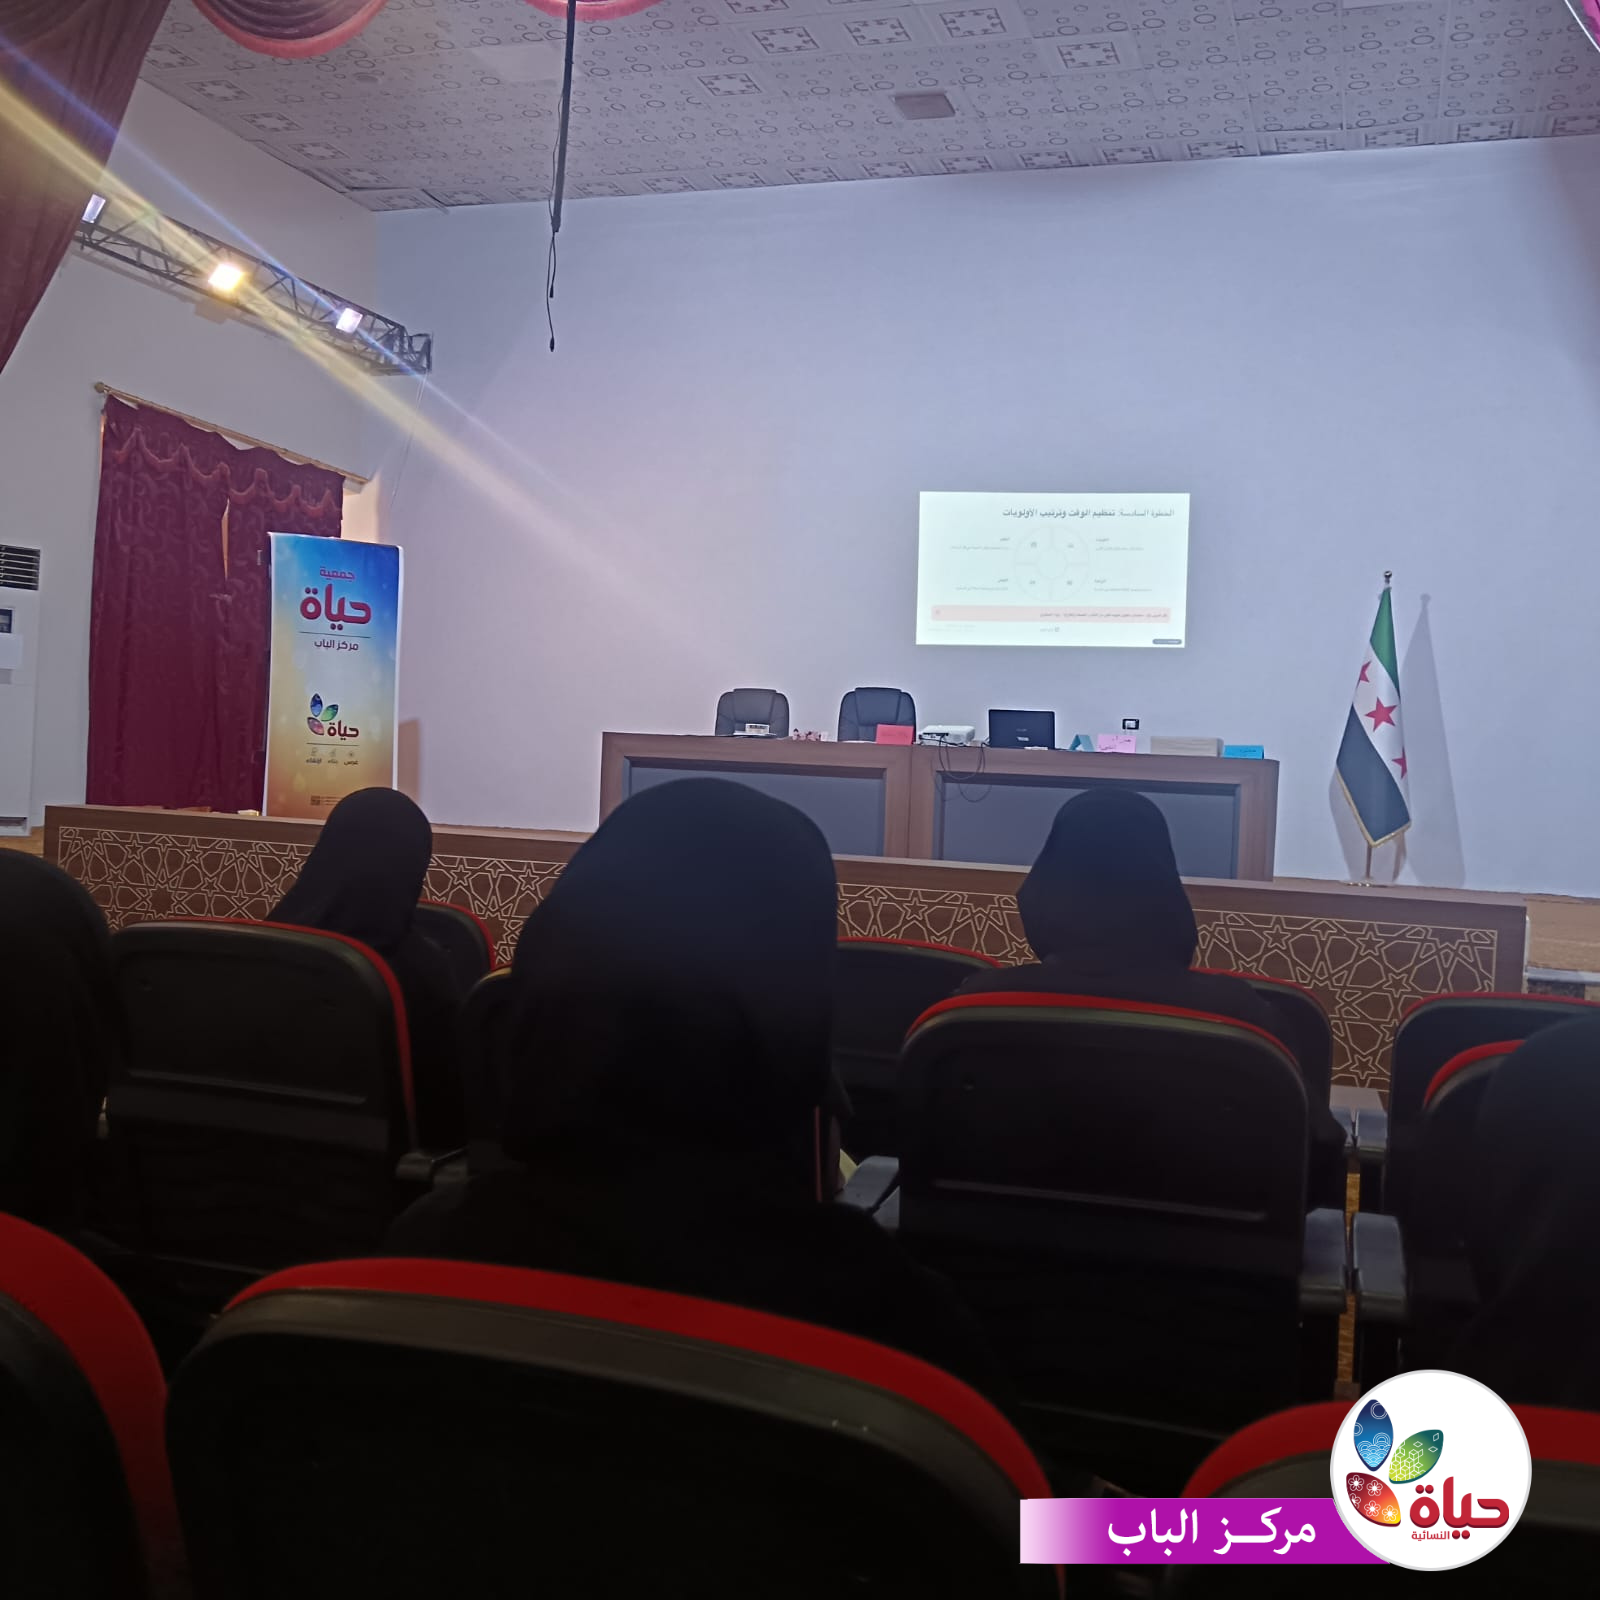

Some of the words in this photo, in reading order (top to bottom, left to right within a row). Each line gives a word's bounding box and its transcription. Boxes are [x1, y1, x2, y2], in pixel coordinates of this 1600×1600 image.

[1040, 507, 1067, 519] وترتيب
[1068, 507, 1090, 518] الوقت
[1092, 507, 1115, 518] تنظيم
[319, 566, 356, 583] جمعية
[300, 583, 372, 631] حياة
[314, 639, 335, 650] الباب
[336, 640, 359, 652] مركز
[327, 719, 360, 741] حياة
